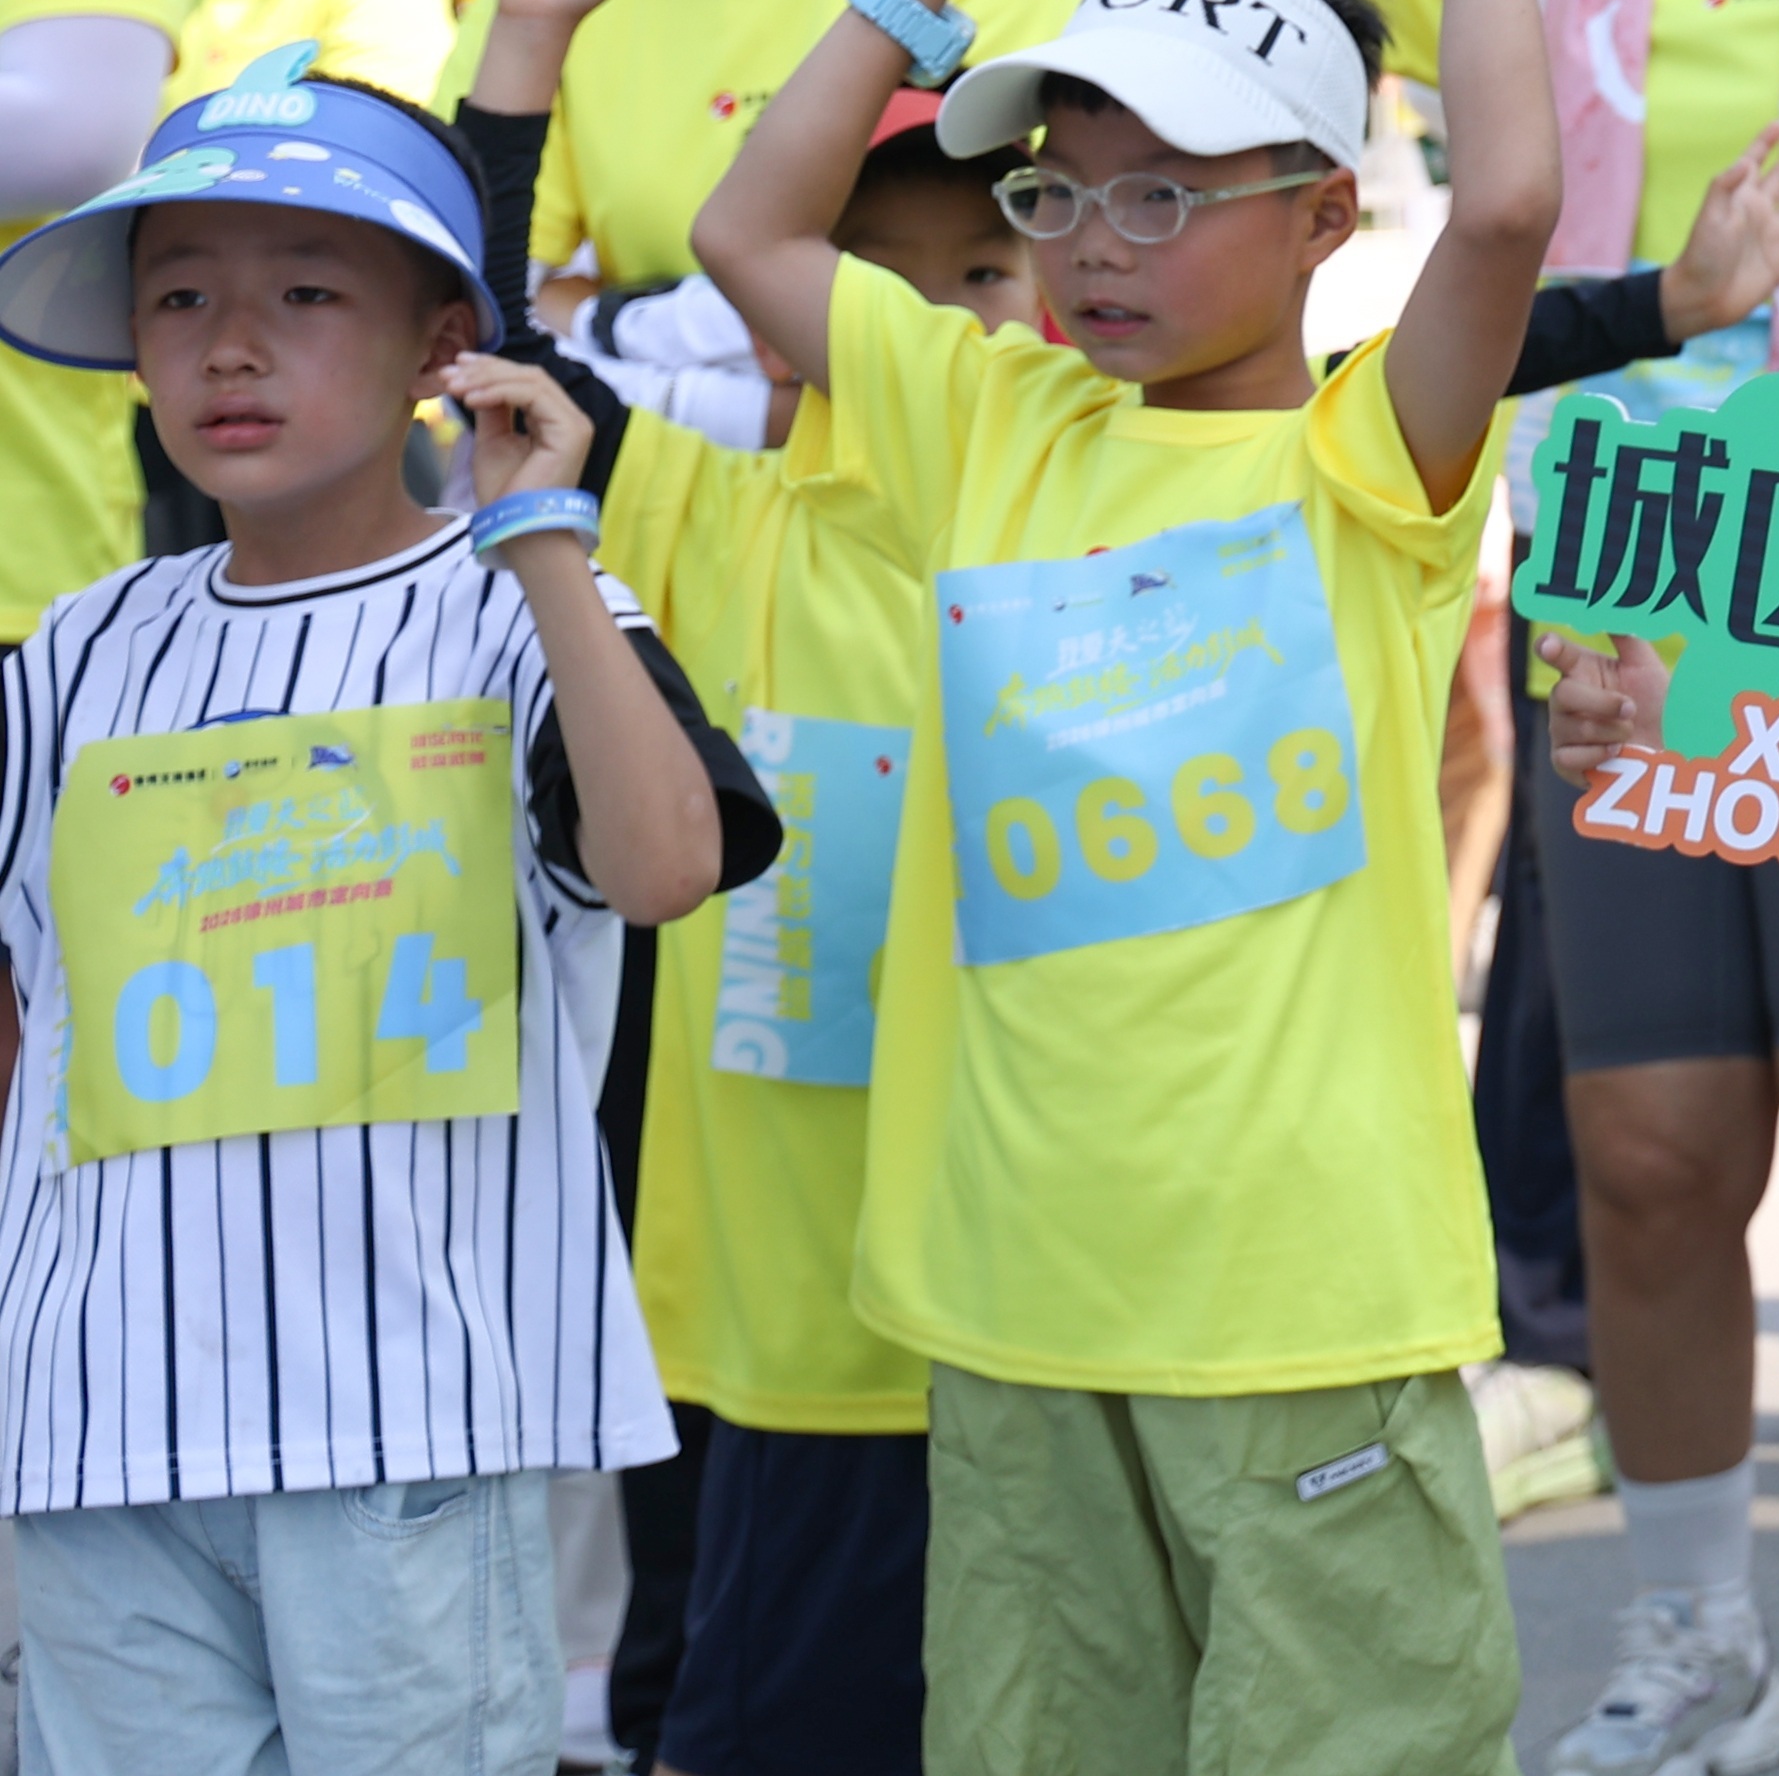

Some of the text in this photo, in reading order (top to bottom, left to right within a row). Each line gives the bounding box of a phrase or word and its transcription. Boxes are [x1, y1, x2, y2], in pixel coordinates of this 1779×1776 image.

[206, 91, 306, 121] DINO
[984, 728, 1350, 901] 0668
[114, 932, 484, 1103] 014
